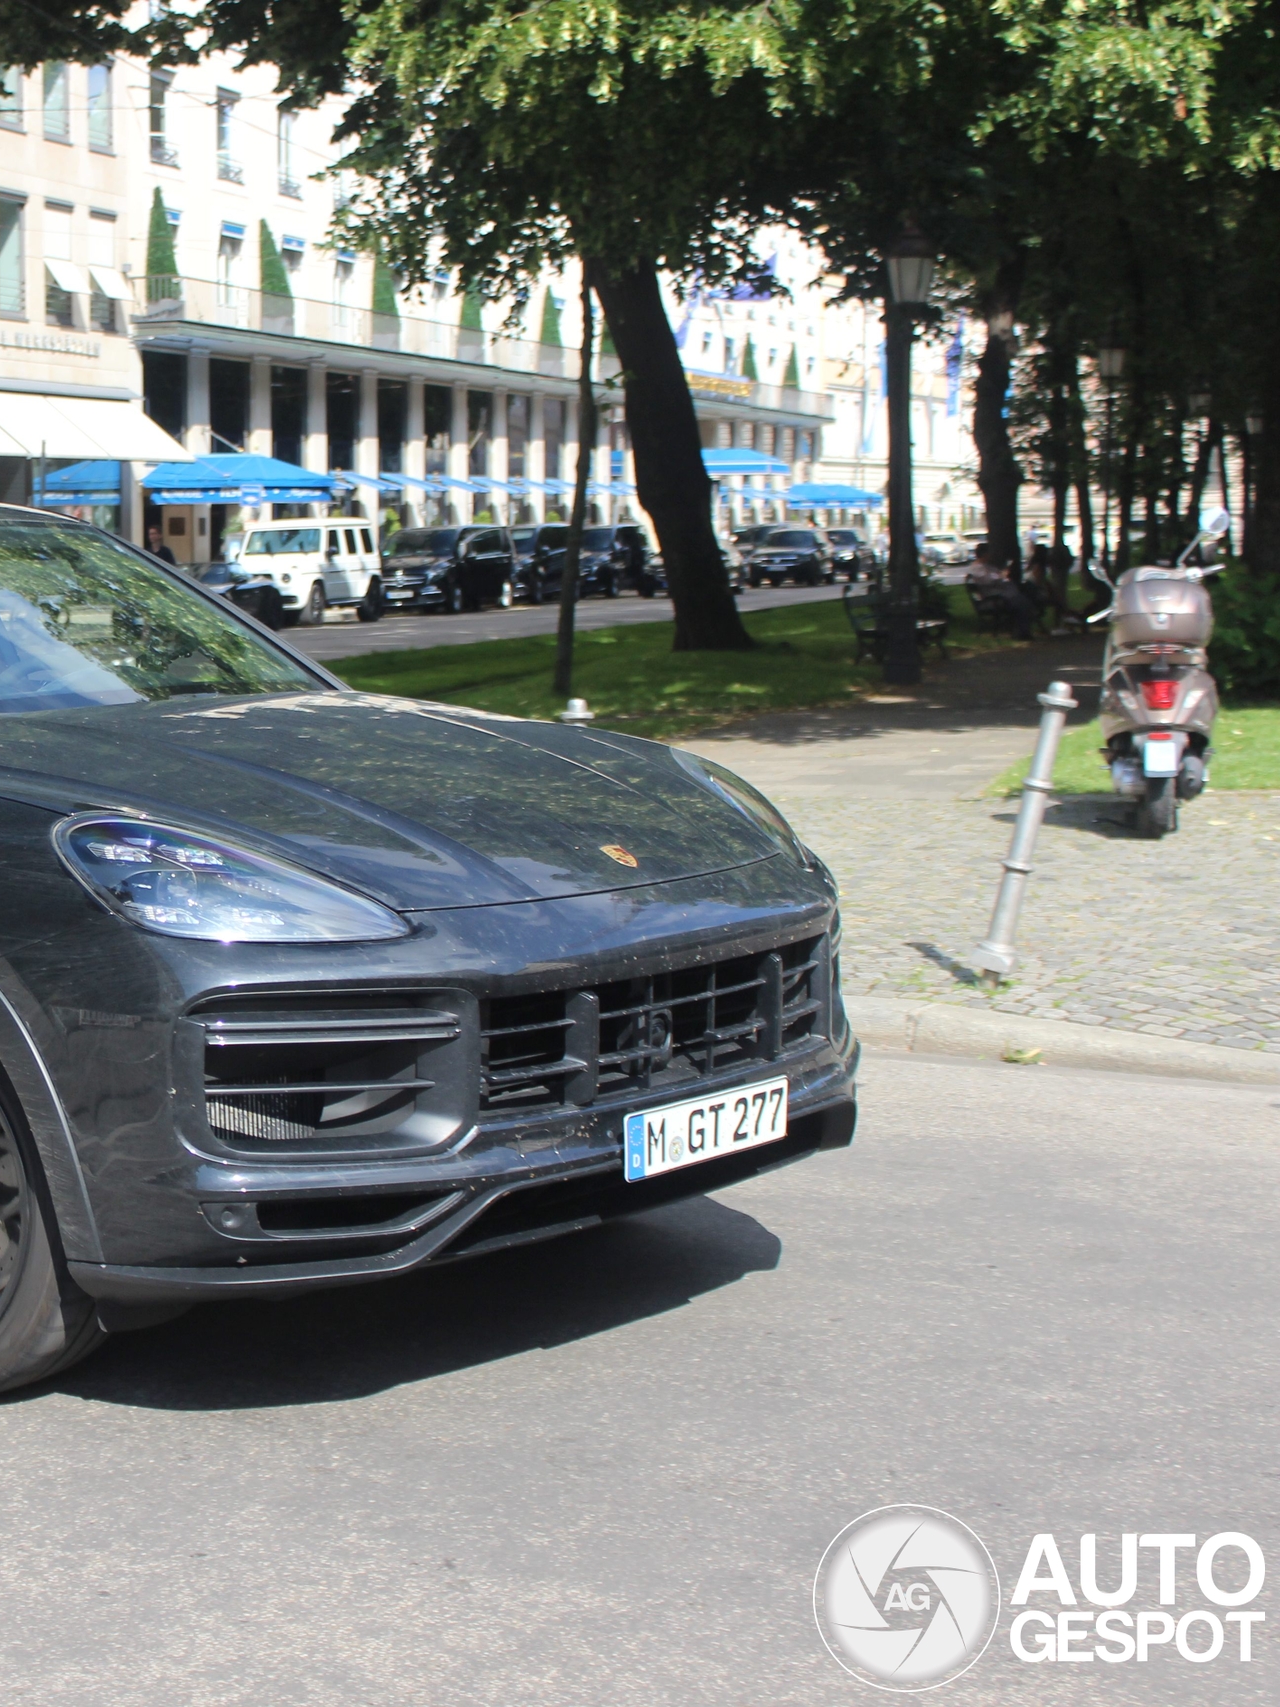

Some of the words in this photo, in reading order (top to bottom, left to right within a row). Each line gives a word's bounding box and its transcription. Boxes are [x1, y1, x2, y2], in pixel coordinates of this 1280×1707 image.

[648, 1117, 665, 1166] M
[688, 1102, 725, 1154] GT
[733, 1087, 783, 1142] 277
[632, 1153, 641, 1168] D
